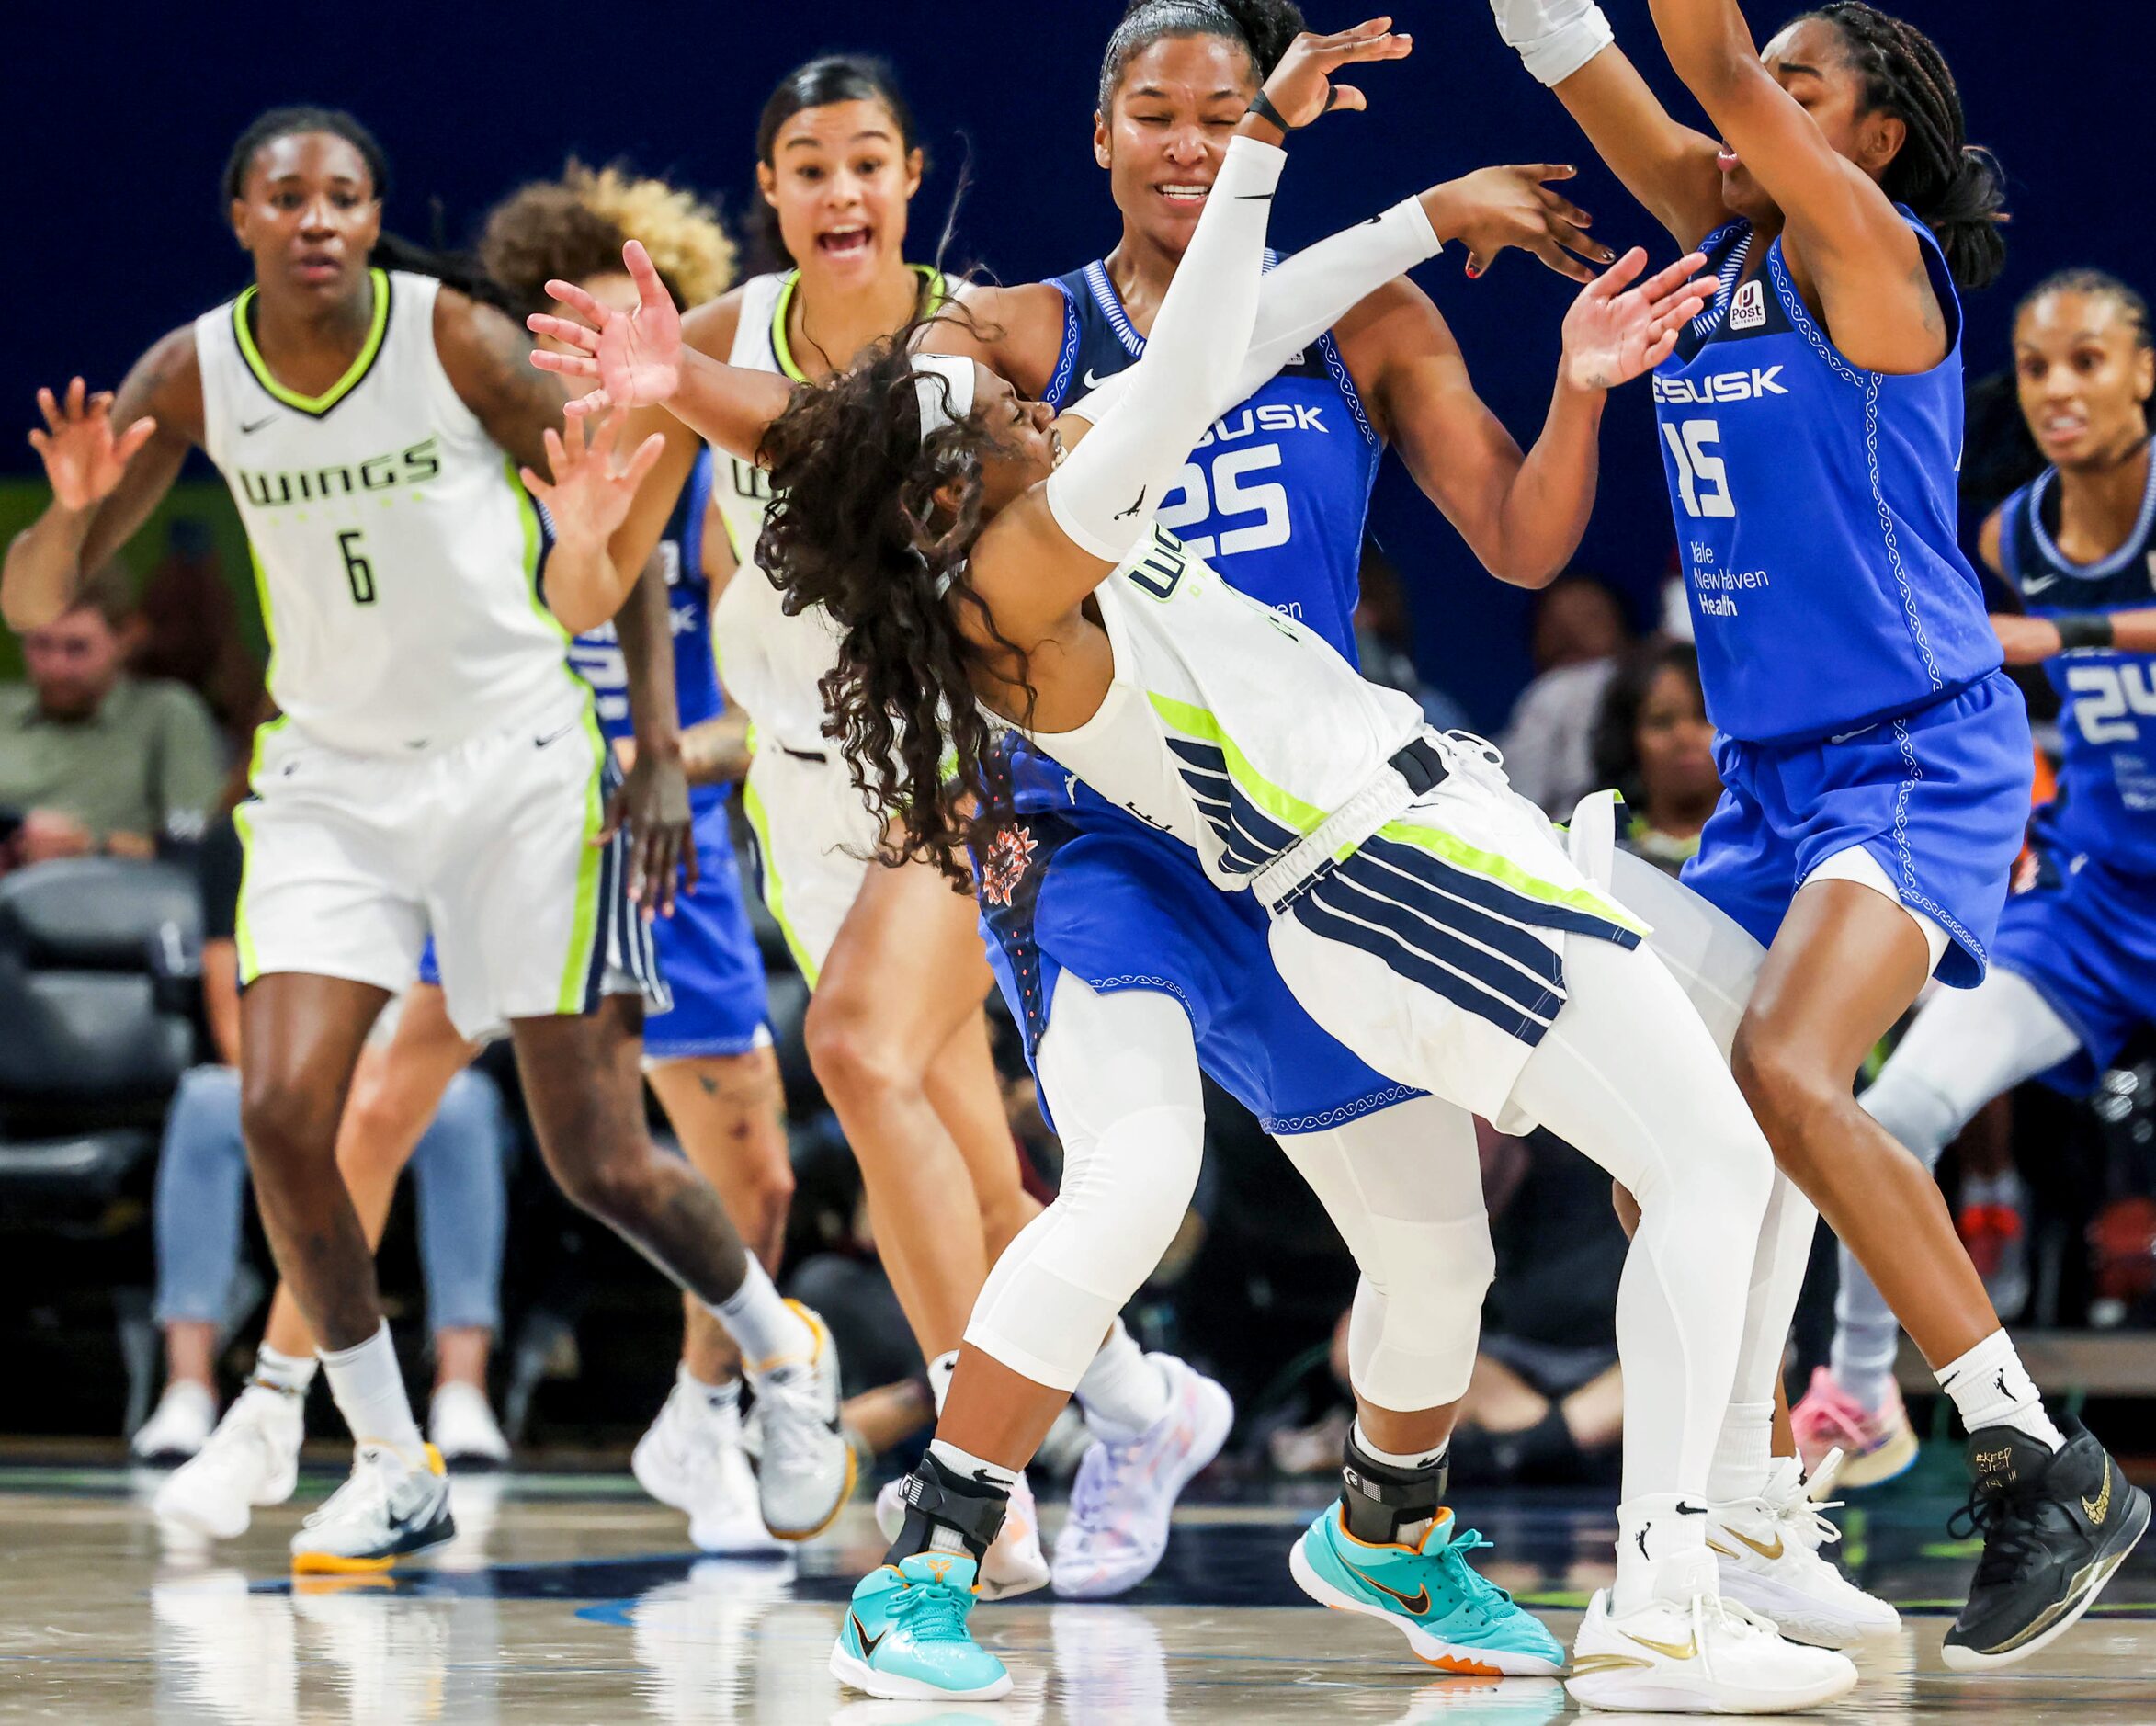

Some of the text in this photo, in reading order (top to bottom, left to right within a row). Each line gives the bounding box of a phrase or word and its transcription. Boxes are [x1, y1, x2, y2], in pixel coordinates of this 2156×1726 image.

[1731, 304, 1763, 321] Post
[240, 436, 439, 506] WINGS
[1152, 442, 1291, 560] 25
[1661, 419, 1736, 517] 15
[337, 528, 376, 605] 6
[1690, 540, 1714, 564] Yale
[1698, 592, 1739, 617] Health
